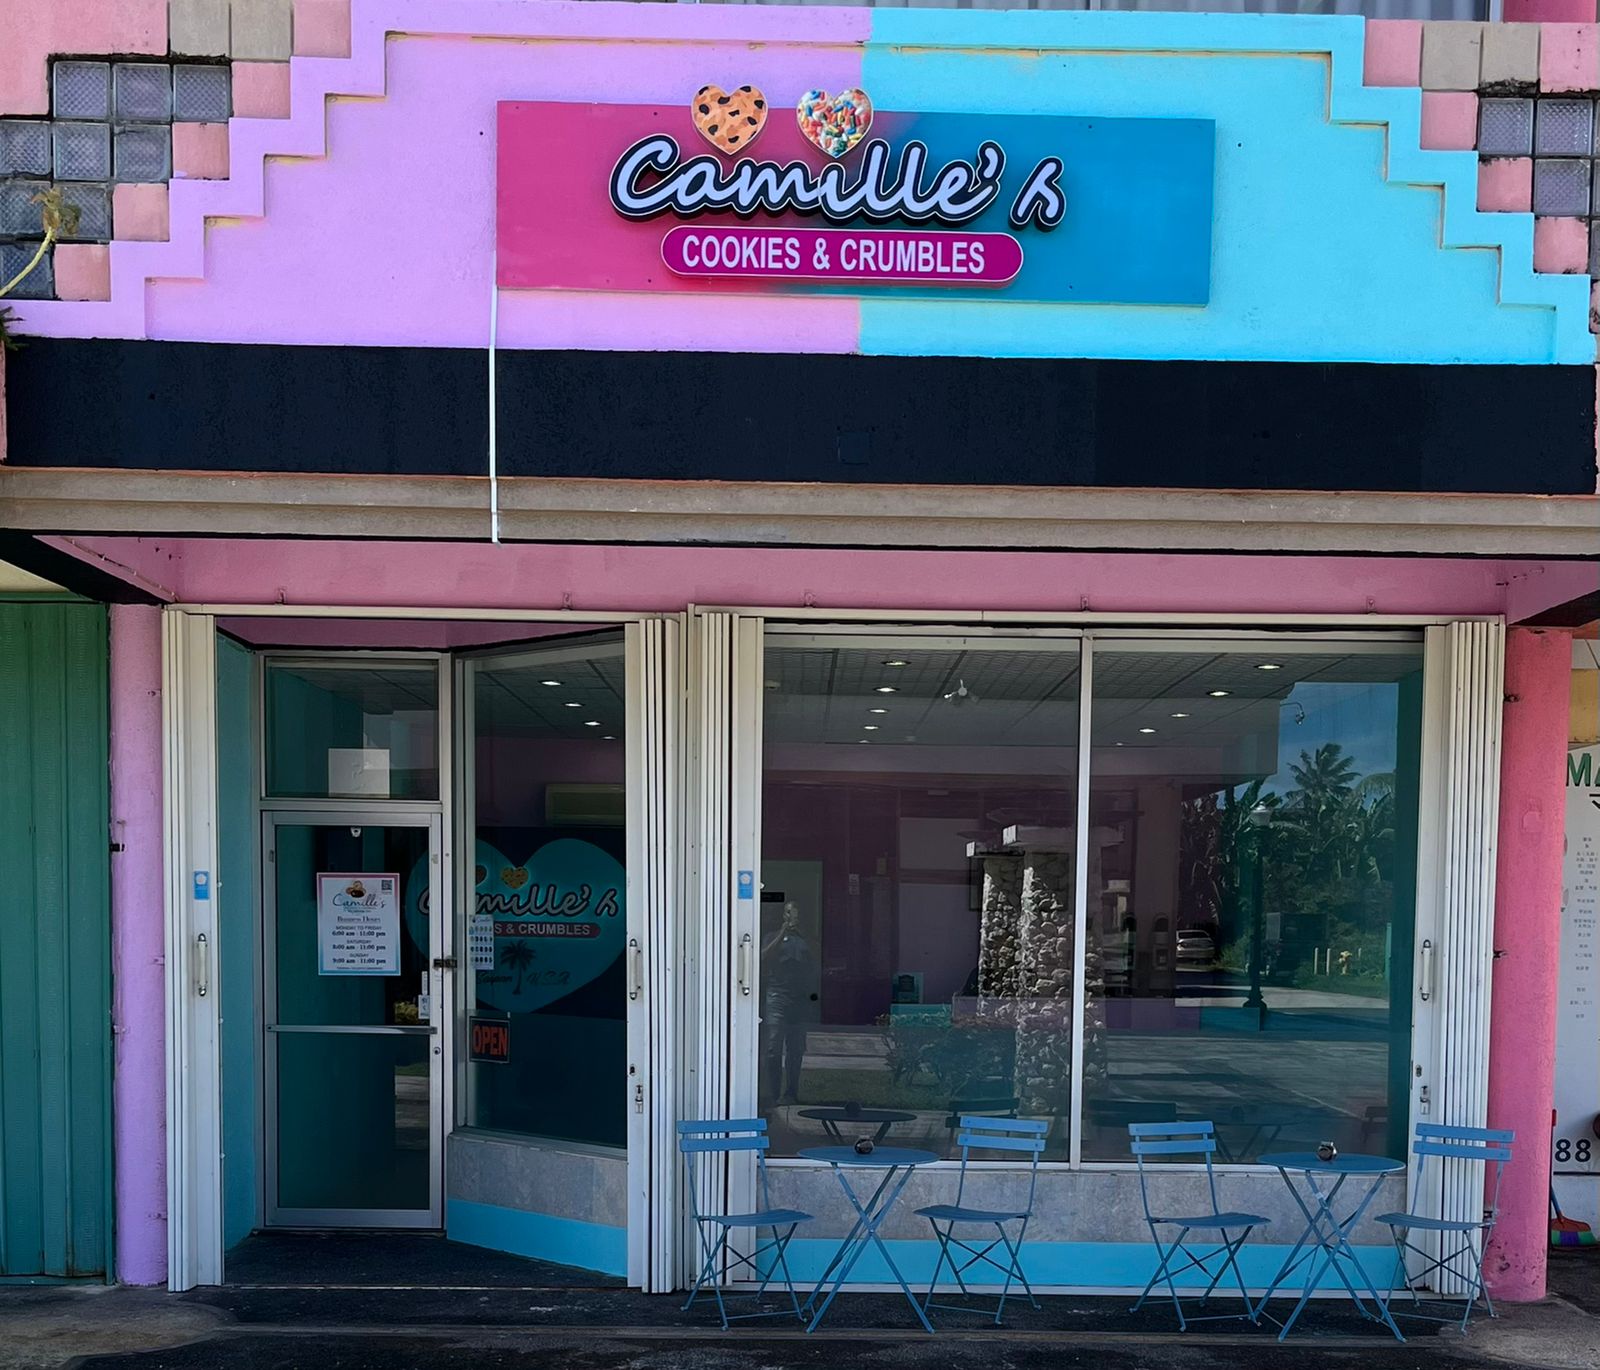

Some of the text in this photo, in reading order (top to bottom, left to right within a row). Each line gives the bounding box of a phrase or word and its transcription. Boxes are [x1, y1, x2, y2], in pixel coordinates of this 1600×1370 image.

[681, 234, 985, 275] COOKIES & CRUMBLES
[1566, 753, 1600, 787] M
[506, 924, 514, 935] &
[518, 923, 590, 936] CRUMBLES
[473, 1025, 508, 1056] OPEN
[1554, 1138, 1591, 1163] 88
